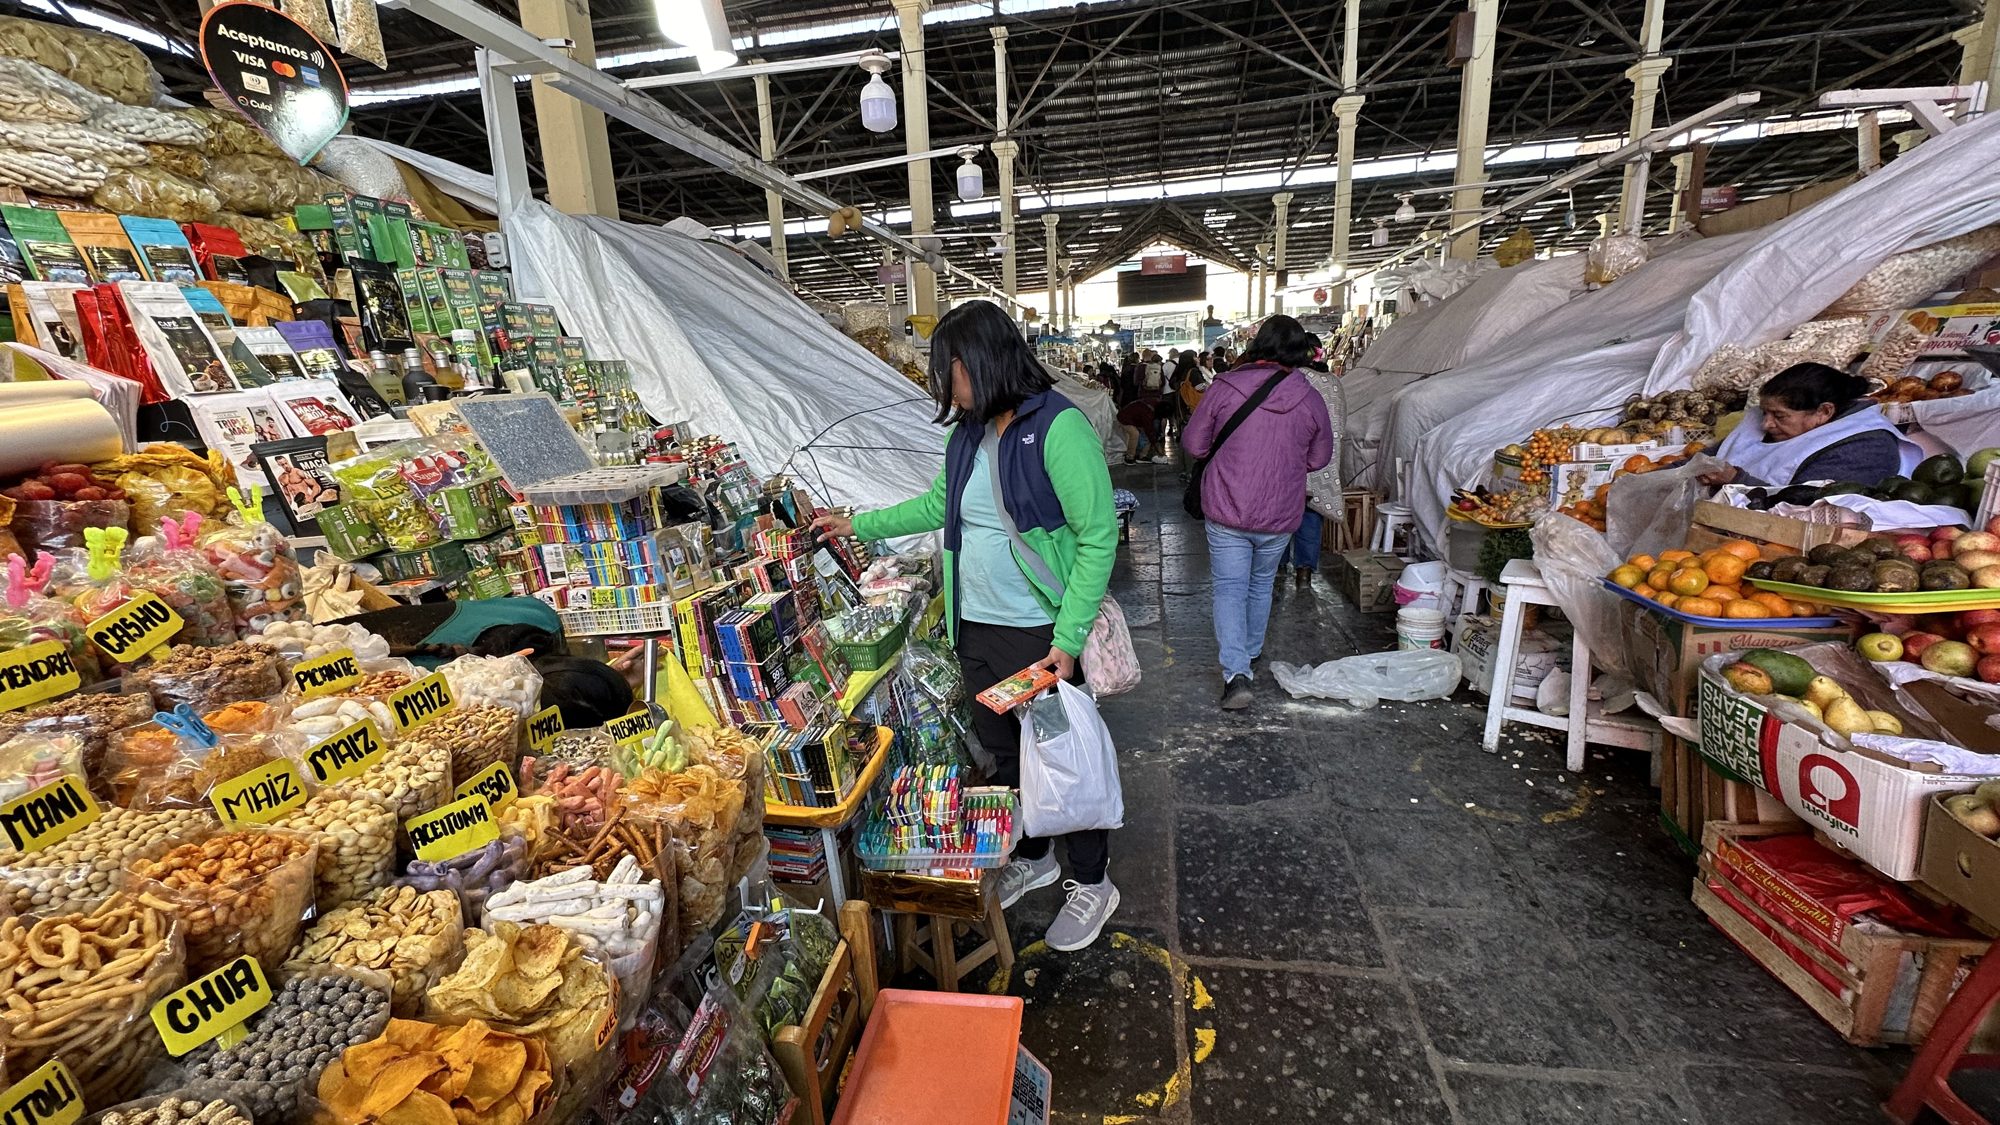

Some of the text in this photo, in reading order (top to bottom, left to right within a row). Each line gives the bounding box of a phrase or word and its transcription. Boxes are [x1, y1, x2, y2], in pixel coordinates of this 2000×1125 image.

[217, 23, 309, 61] Aceptamos
[232, 49, 268, 69] VISA
[300, 456, 329, 471] MACA
[93, 600, 170, 654] CASHU
[295, 656, 359, 692] PICANTE
[530, 713, 562, 744] MAIZ
[1703, 682, 1763, 733] PEARS
[1703, 702, 1761, 750] PEARS
[308, 726, 379, 782] MAIZ
[1703, 720, 1761, 772] PEARS
[1704, 737, 1766, 790] PEARS
[409, 802, 490, 850] ACEITUNA
[1800, 798, 1860, 839] unifrutti
[165, 958, 261, 1035] CHIA
